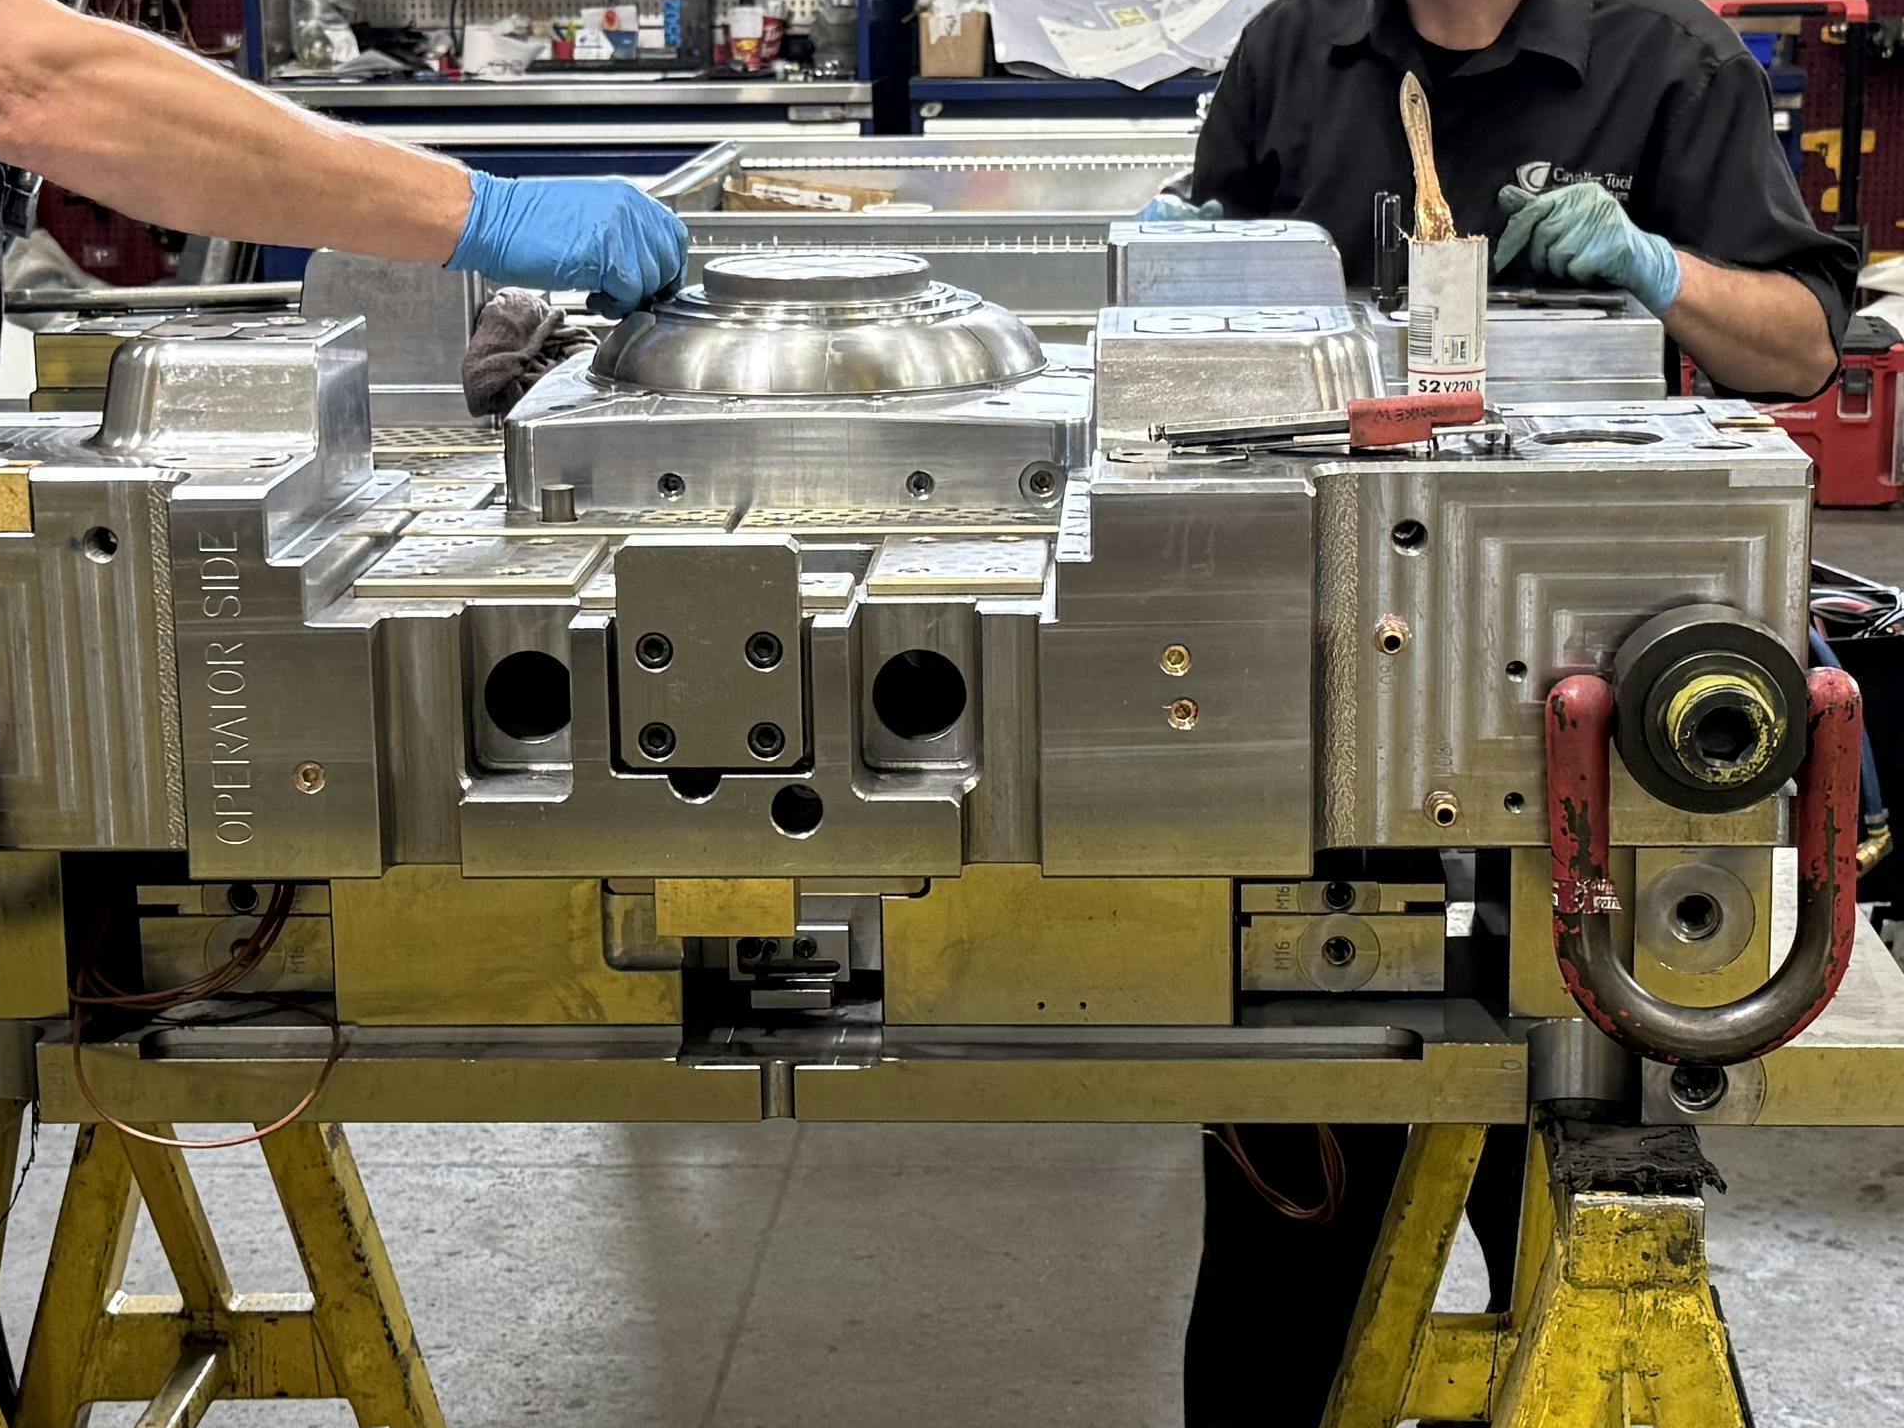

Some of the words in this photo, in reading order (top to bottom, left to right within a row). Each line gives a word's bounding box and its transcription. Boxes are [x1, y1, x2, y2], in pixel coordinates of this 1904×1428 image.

[1417, 379, 1441, 393] S2
[197, 530, 242, 618] SIDE
[203, 642, 254, 846] OPERATOR
[1275, 885, 1291, 911] M16
[1275, 940, 1291, 971] M16
